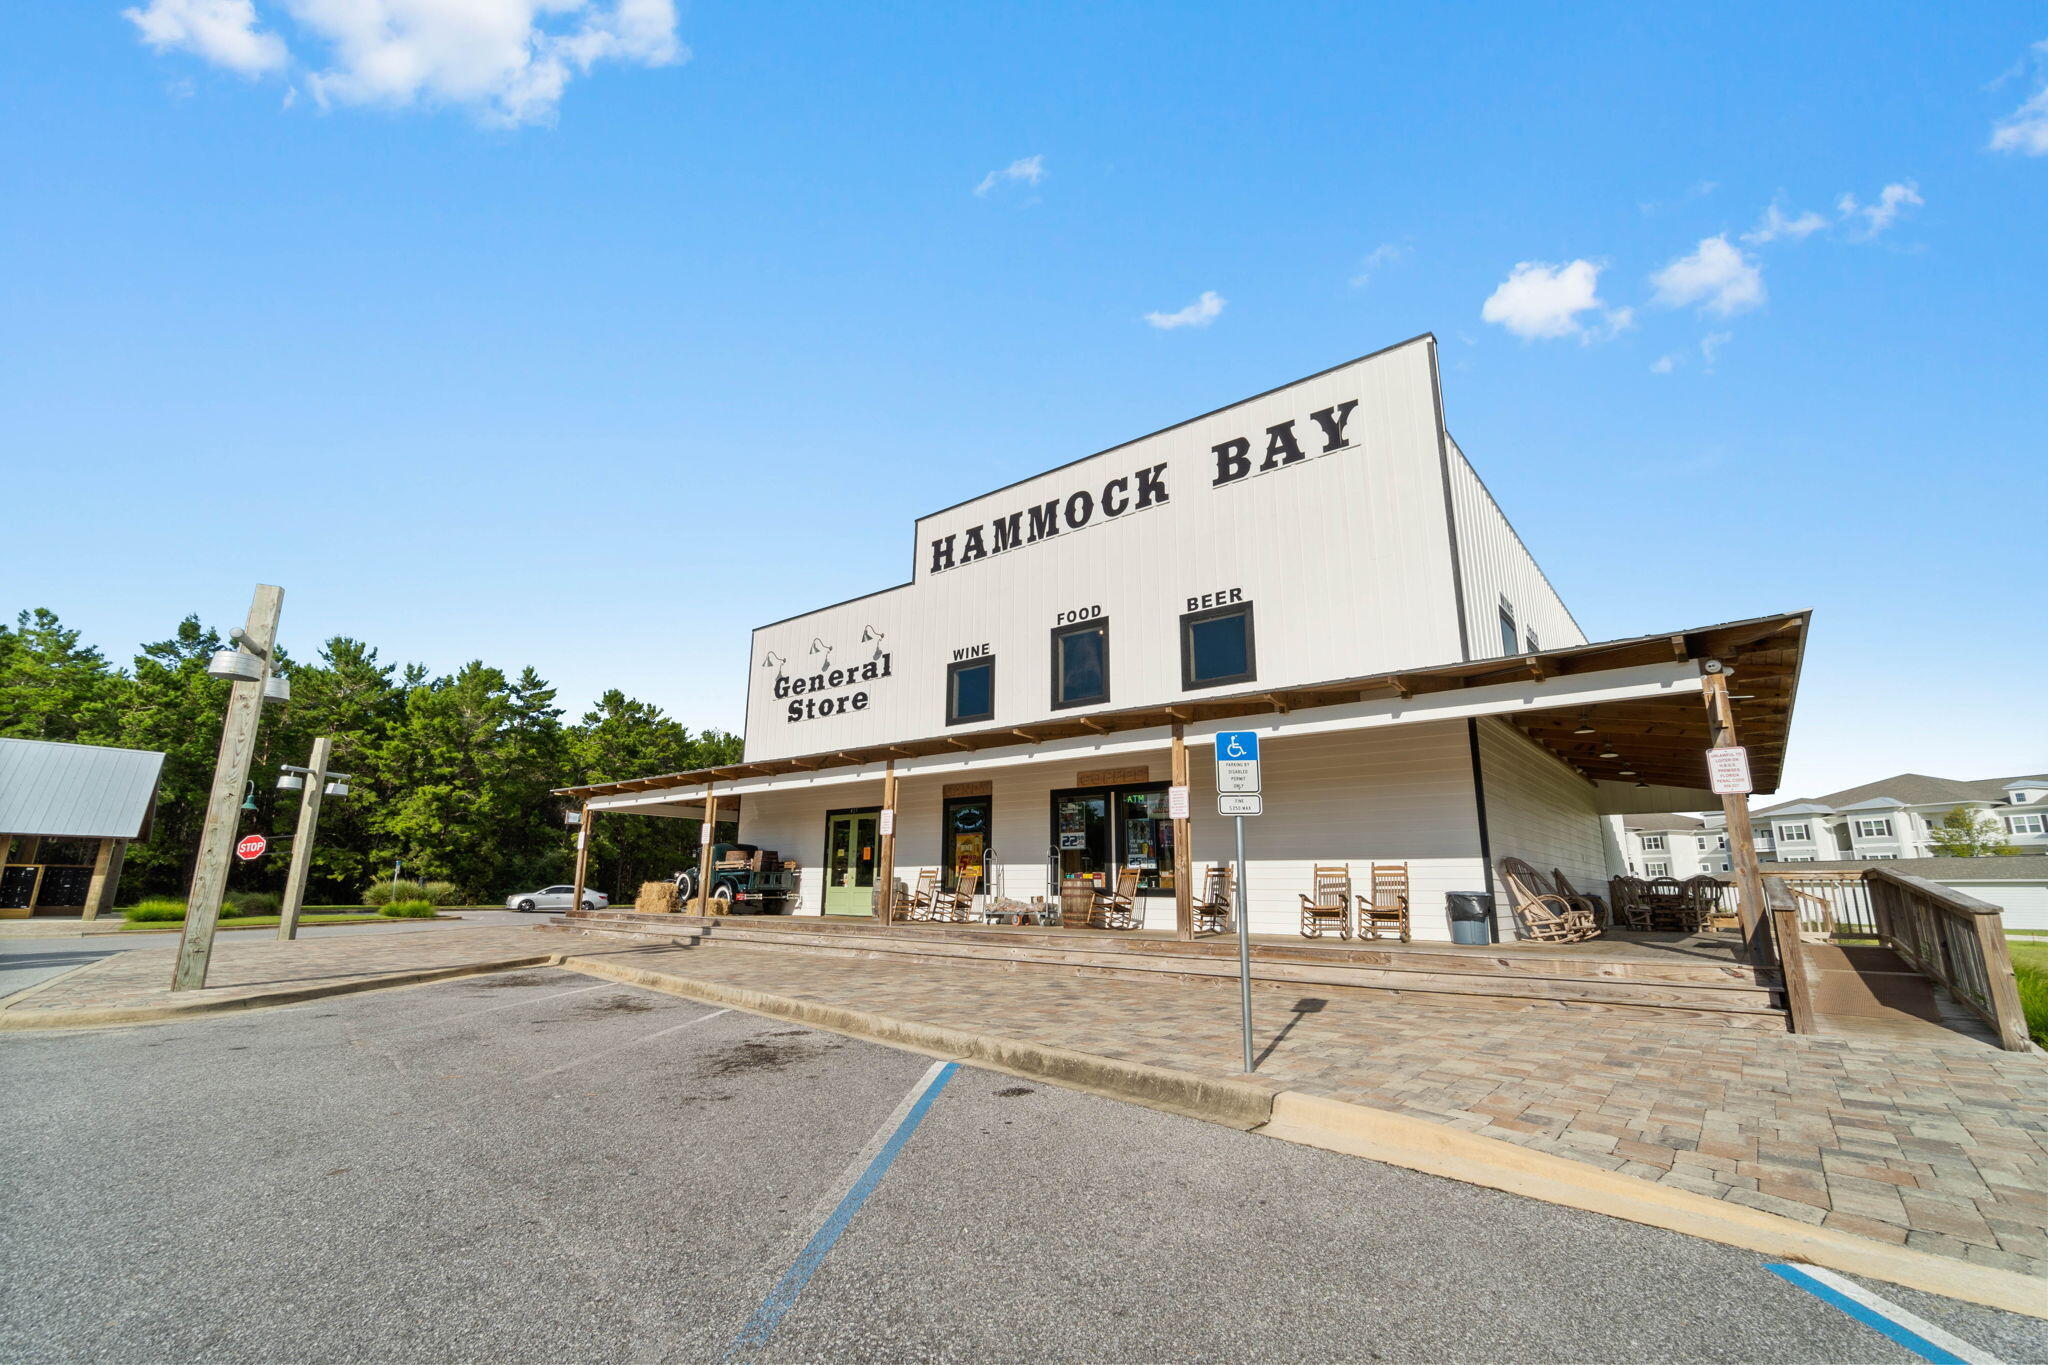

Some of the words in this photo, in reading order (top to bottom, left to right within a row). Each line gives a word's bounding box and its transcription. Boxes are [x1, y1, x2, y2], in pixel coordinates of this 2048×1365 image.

[931, 462, 1169, 573] HAMMOCK
[1212, 399, 1358, 486] BAY
[1187, 588, 1243, 612] BEER
[1057, 605, 1101, 625] FOOD
[953, 643, 990, 661] WINE
[774, 653, 891, 699] General
[788, 692, 868, 723] Store
[1127, 795, 1144, 803] ATM
[239, 842, 263, 853] STOP
